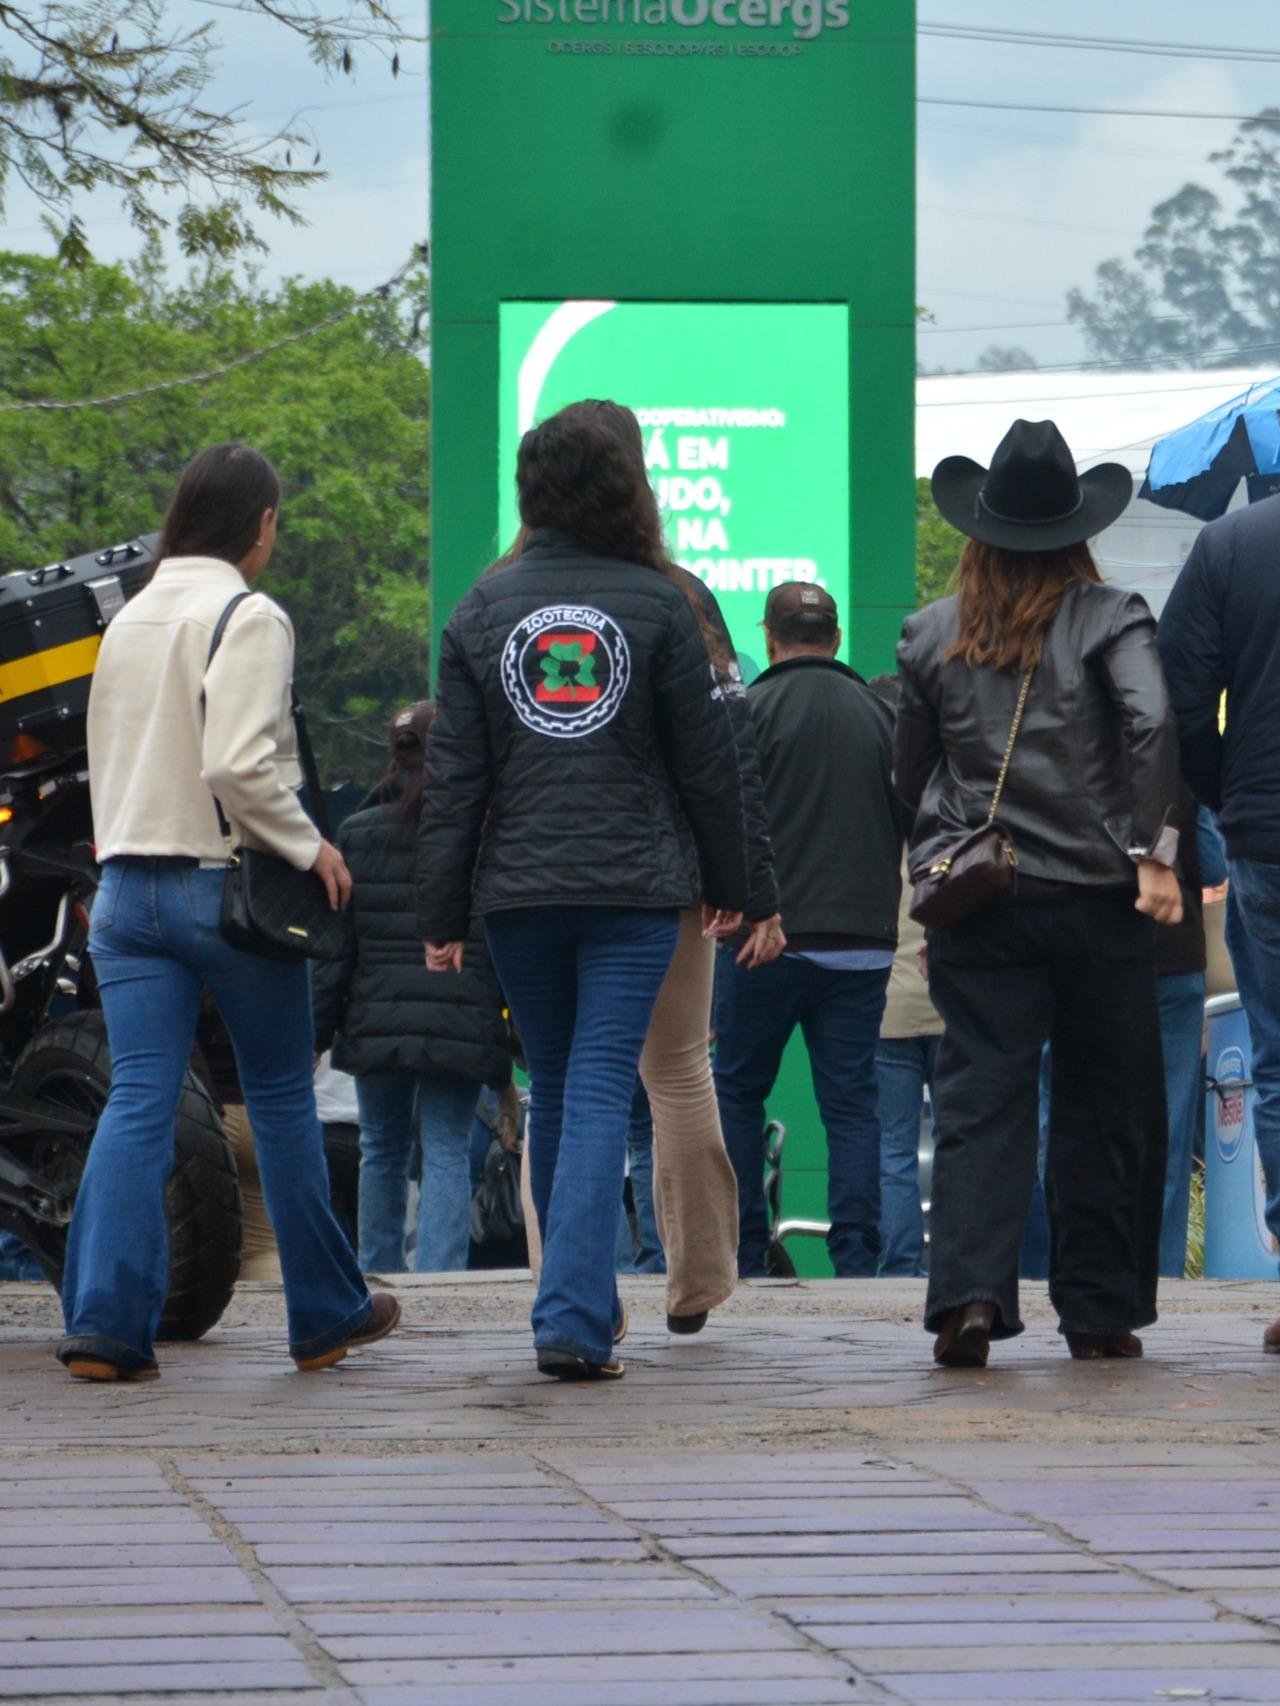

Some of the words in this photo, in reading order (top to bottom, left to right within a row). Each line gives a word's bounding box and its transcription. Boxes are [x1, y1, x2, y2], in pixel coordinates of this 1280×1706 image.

[499, 0, 850, 39] SistemaOcergs
[548, 41, 613, 54] OCERGS
[636, 407, 785, 427] OOPERATIVISMO:
[677, 436, 729, 470] EM
[521, 609, 606, 635] ZOOTECNIA
